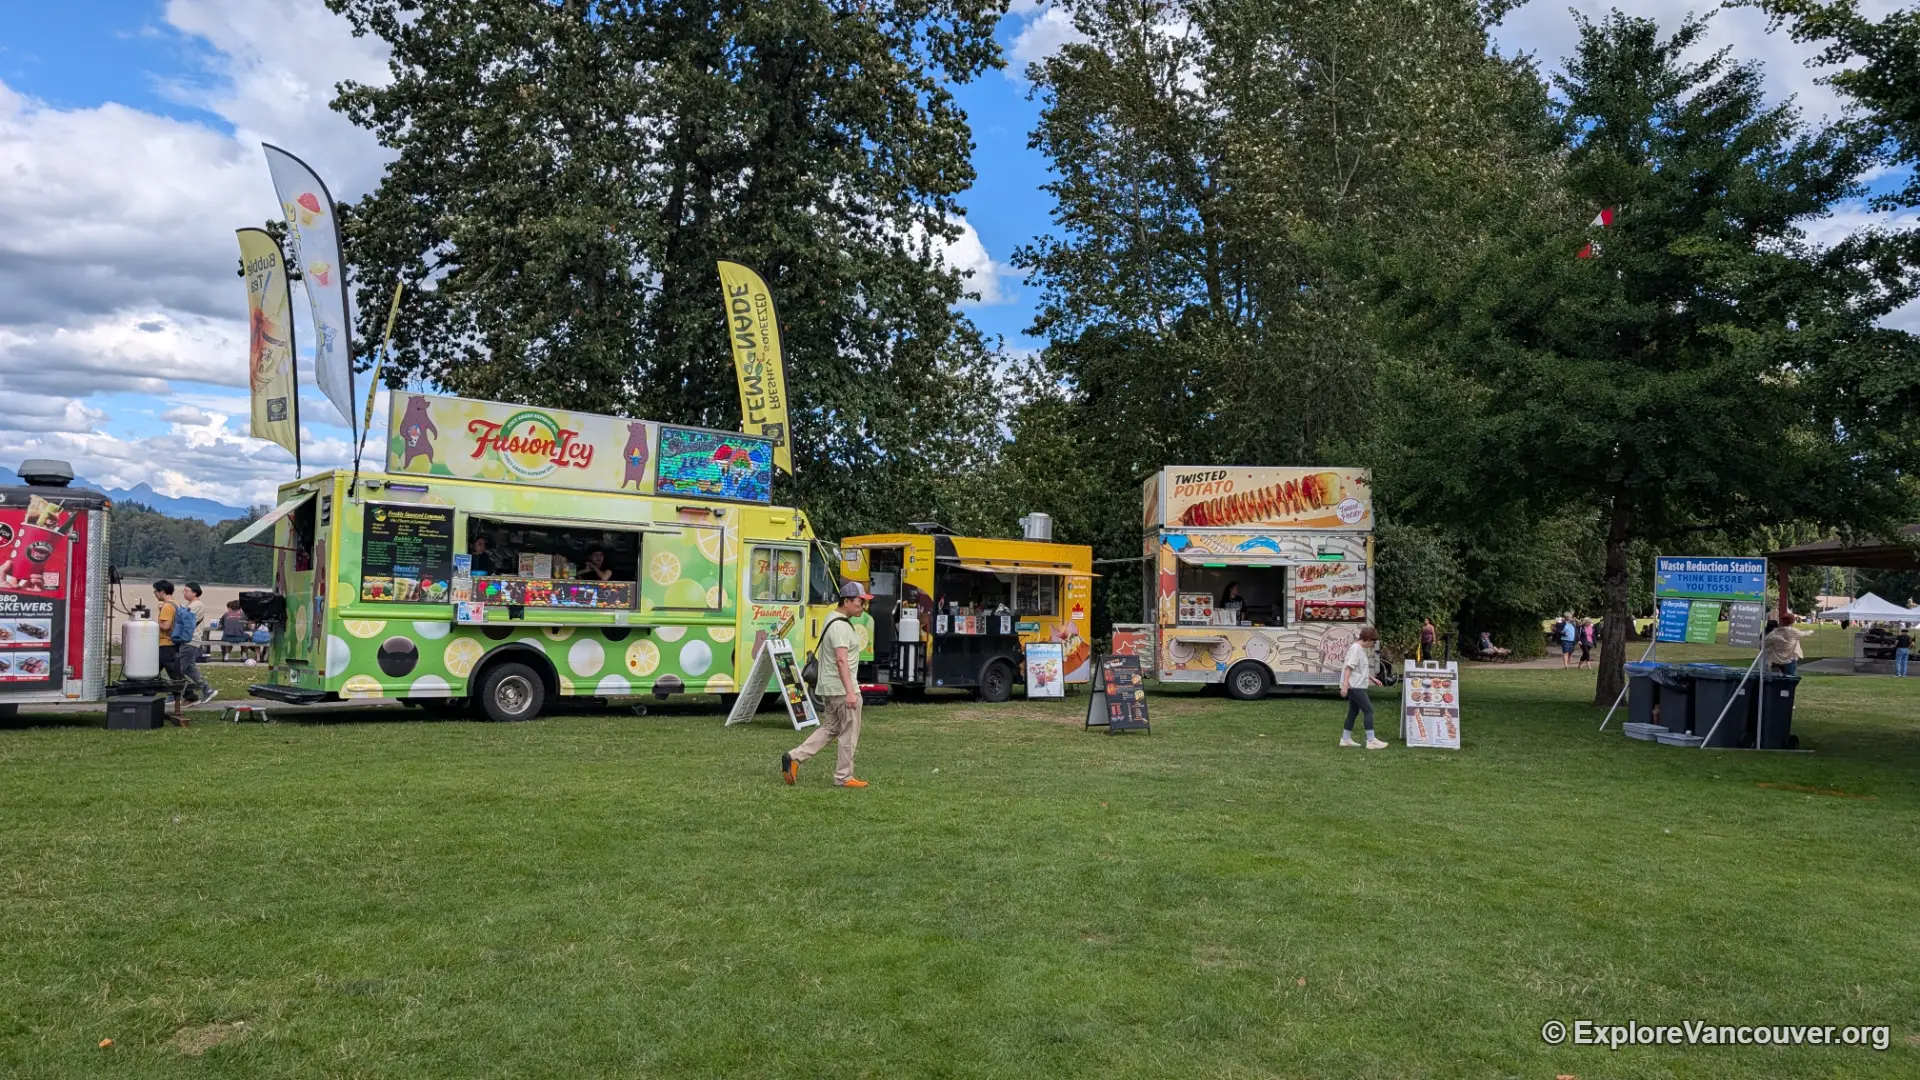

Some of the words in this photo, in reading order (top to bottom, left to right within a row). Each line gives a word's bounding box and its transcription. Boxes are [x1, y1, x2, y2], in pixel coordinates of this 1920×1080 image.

[1175, 470, 1227, 485] TWISTED
[1173, 480, 1234, 498] POTATO
[1661, 560, 1685, 571] Waste
[1686, 561, 1729, 572] Reduction
[1730, 561, 1762, 573] Station
[1677, 574, 1705, 582] THINK
[1707, 575, 1743, 583] BEFORE
[1686, 583, 1704, 591] YOU
[1707, 584, 1733, 592] TOSS!
[0, 602, 53, 612] SKEWERS
[1738, 605, 1760, 613] Garbage
